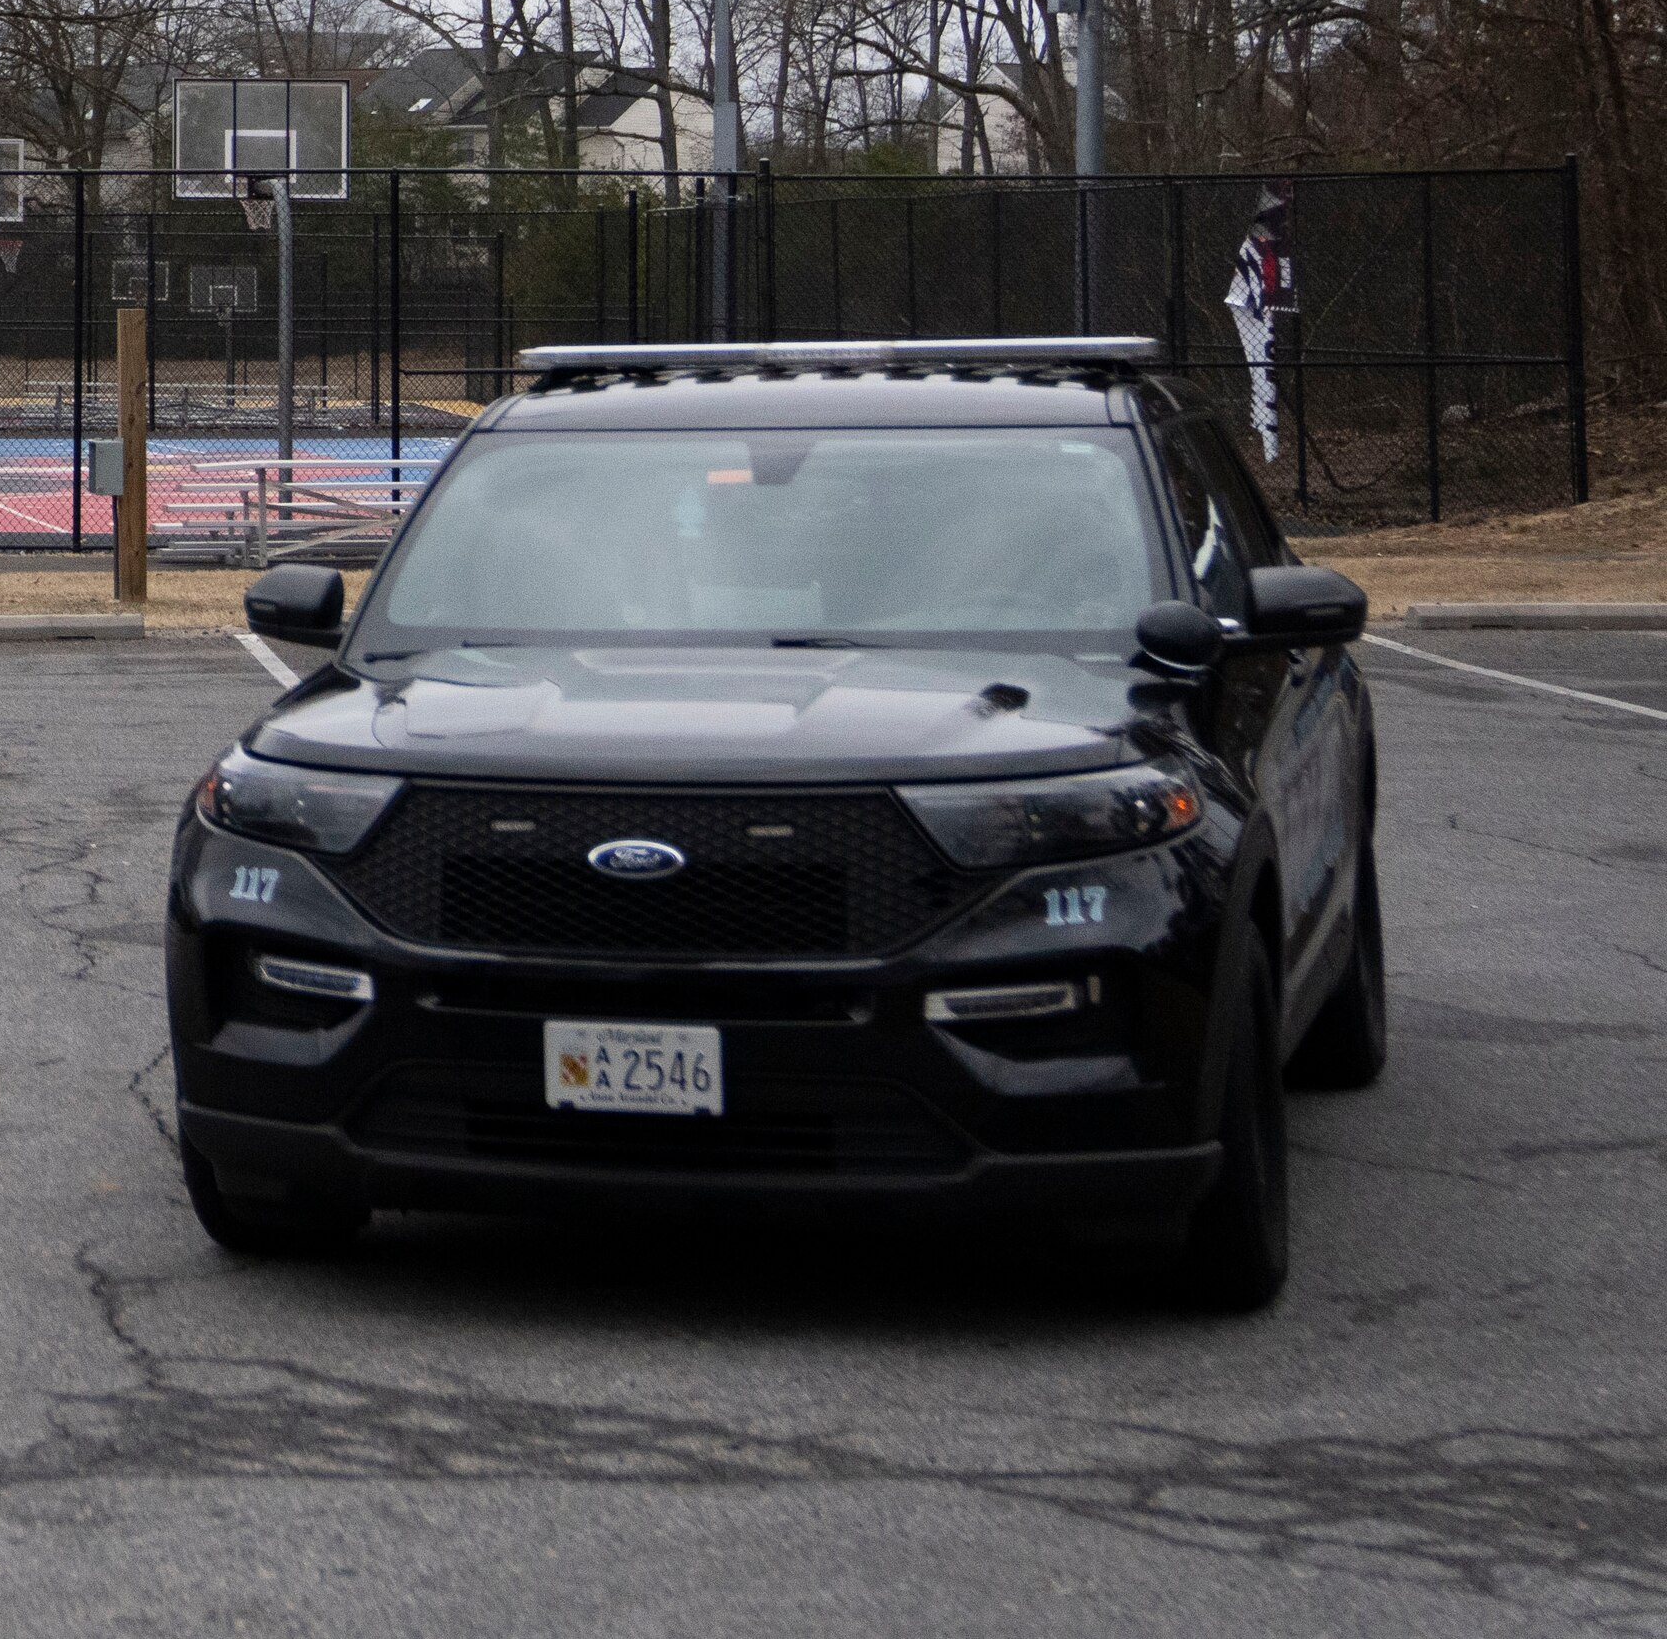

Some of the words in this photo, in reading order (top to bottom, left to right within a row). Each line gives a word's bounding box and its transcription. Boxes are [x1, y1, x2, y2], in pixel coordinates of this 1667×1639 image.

[229, 865, 280, 903] 117
[1043, 886, 1107, 926] 117
[623, 1049, 711, 1092] 2546
